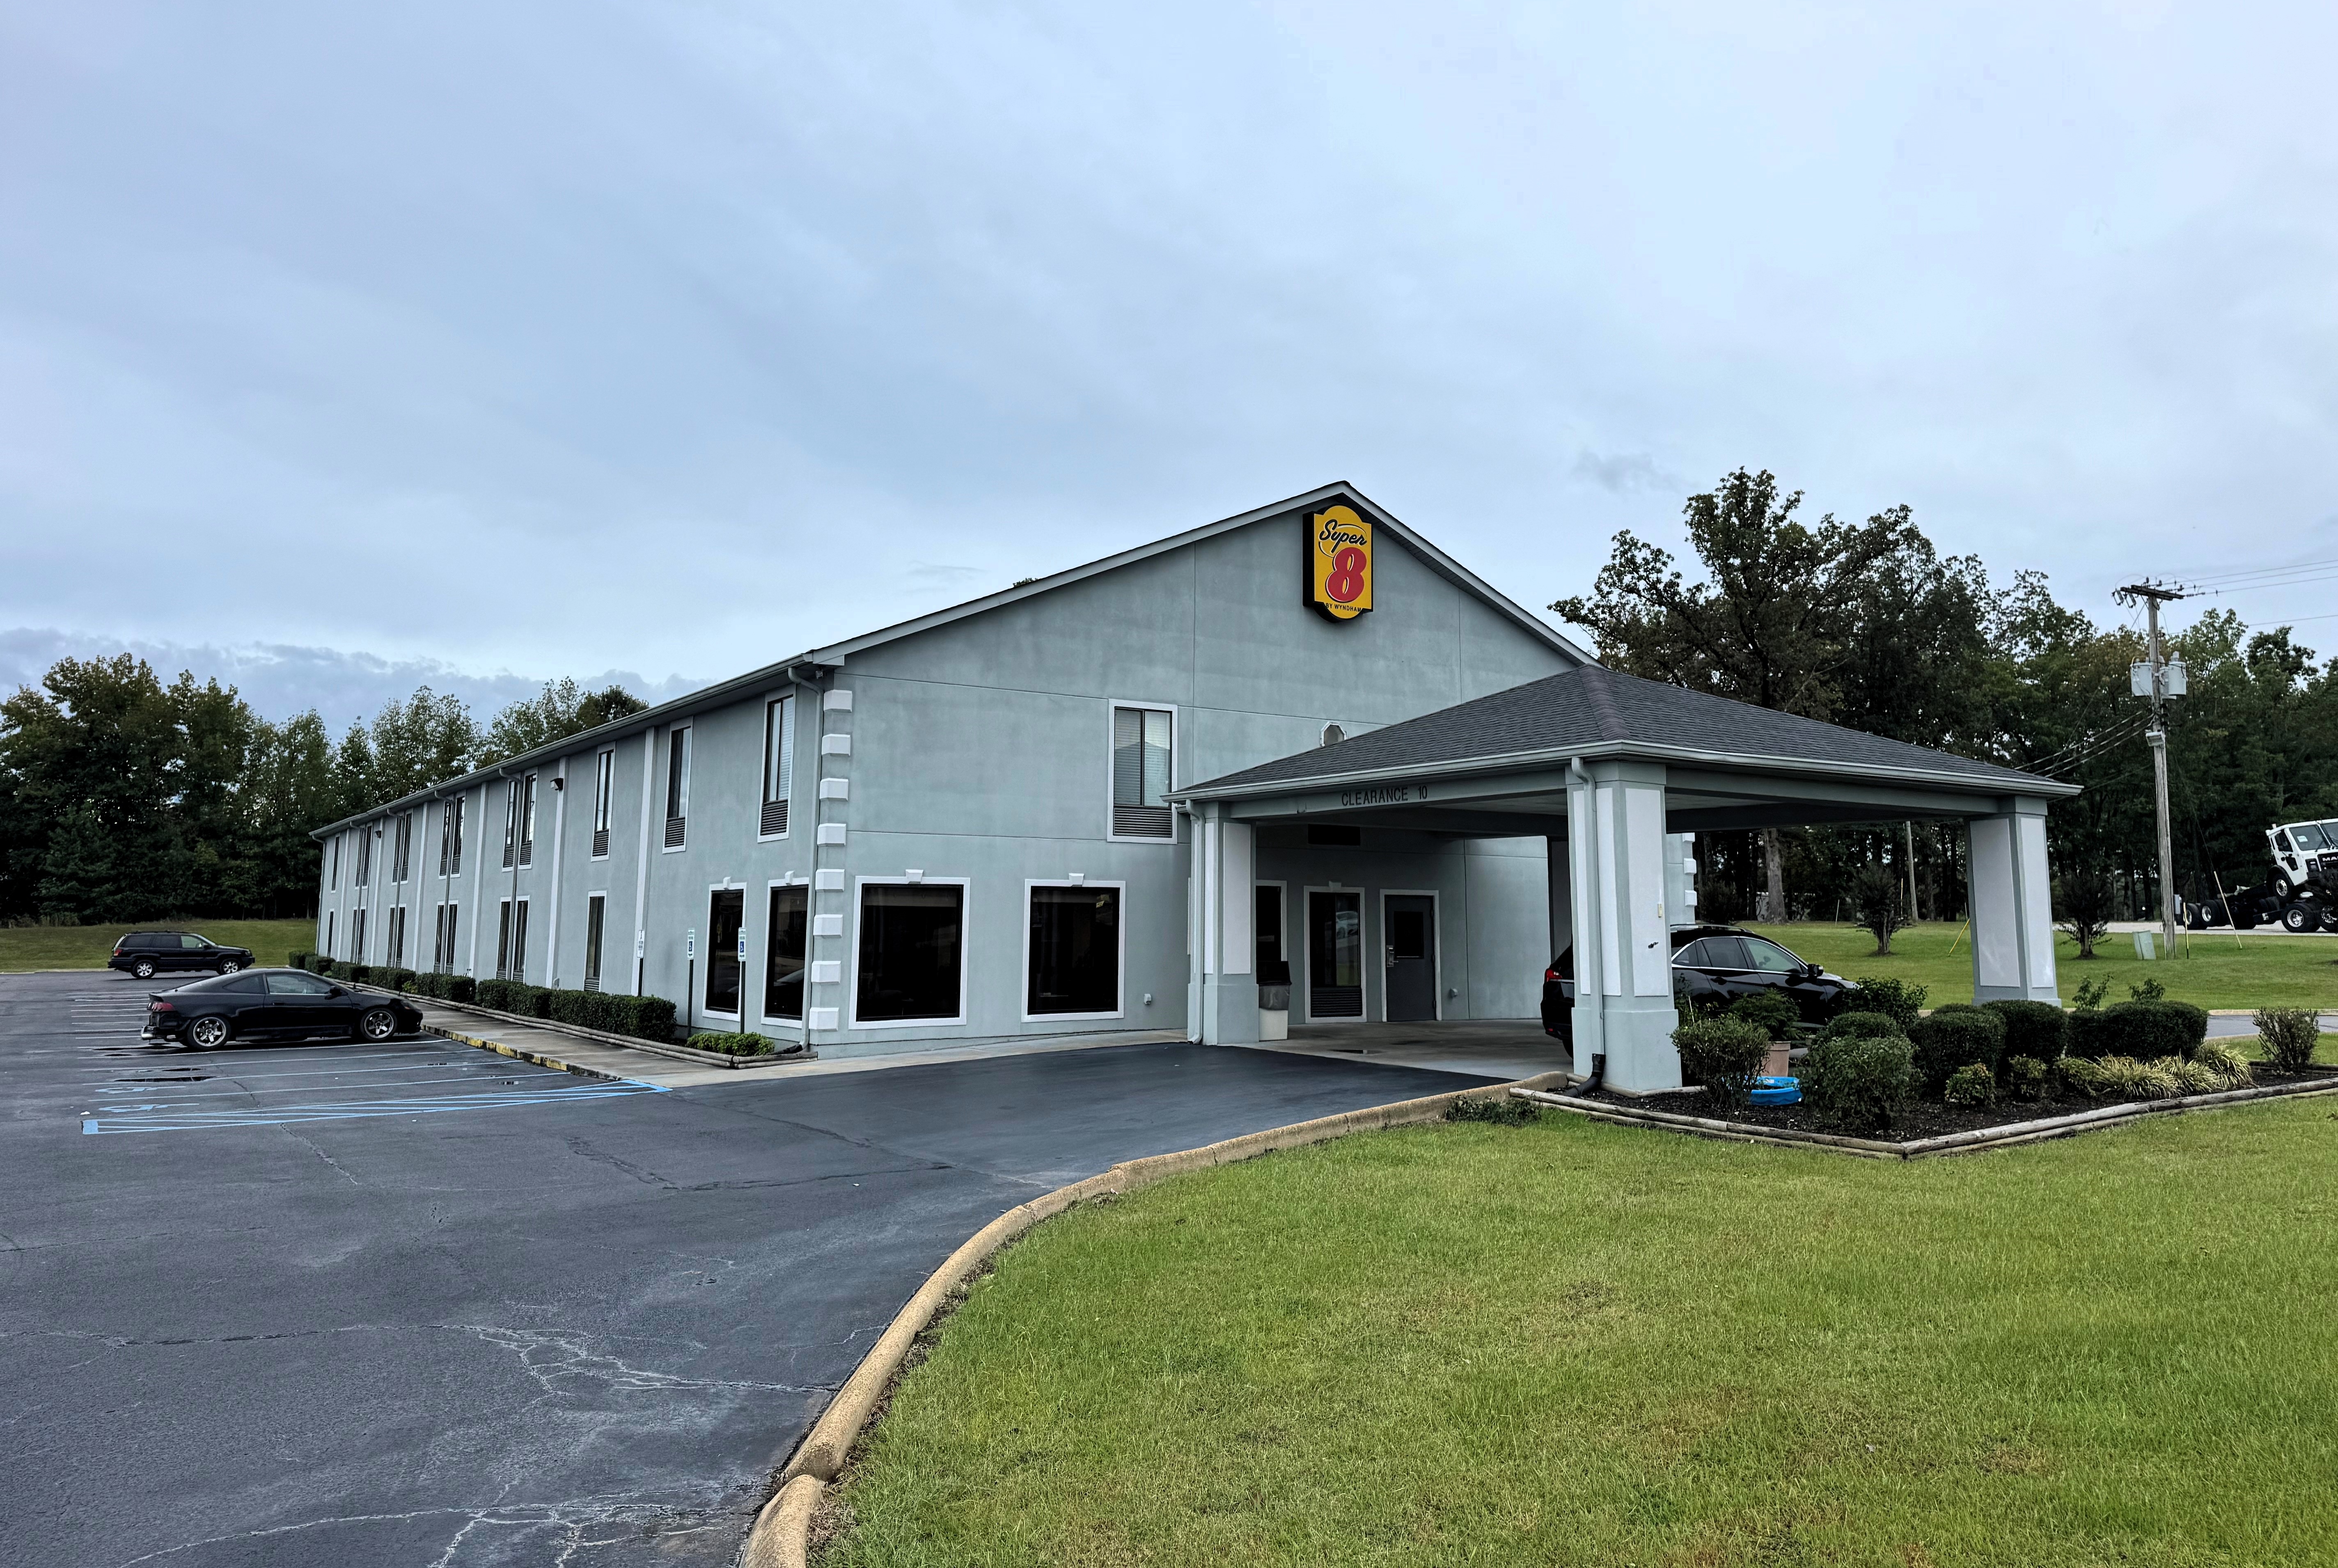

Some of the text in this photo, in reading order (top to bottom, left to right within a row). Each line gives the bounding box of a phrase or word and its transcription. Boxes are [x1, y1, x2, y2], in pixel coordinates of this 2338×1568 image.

[1319, 519, 1367, 553] Super
[1325, 547, 1367, 603] 8
[1341, 785, 1427, 806] CLEARANCE 10
